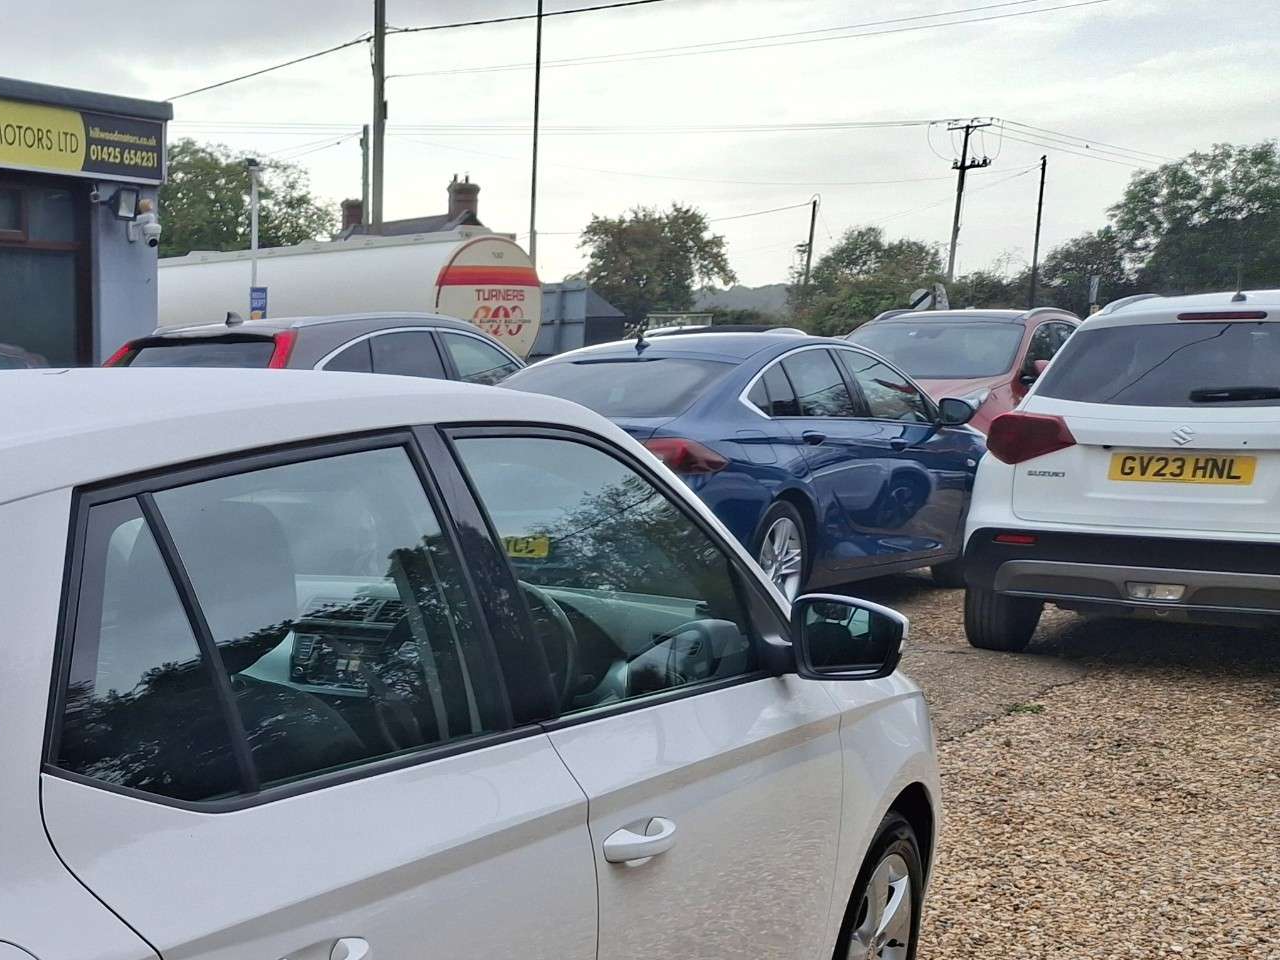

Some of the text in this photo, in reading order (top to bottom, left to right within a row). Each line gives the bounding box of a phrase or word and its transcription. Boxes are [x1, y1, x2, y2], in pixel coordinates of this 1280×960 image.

[58, 130, 79, 154] LTD
[90, 144, 158, 168] 01425 654231
[475, 289, 525, 301] TURNERS
[1027, 469, 1066, 478] SUZUKI
[1120, 455, 1242, 480] GV23 HNL
